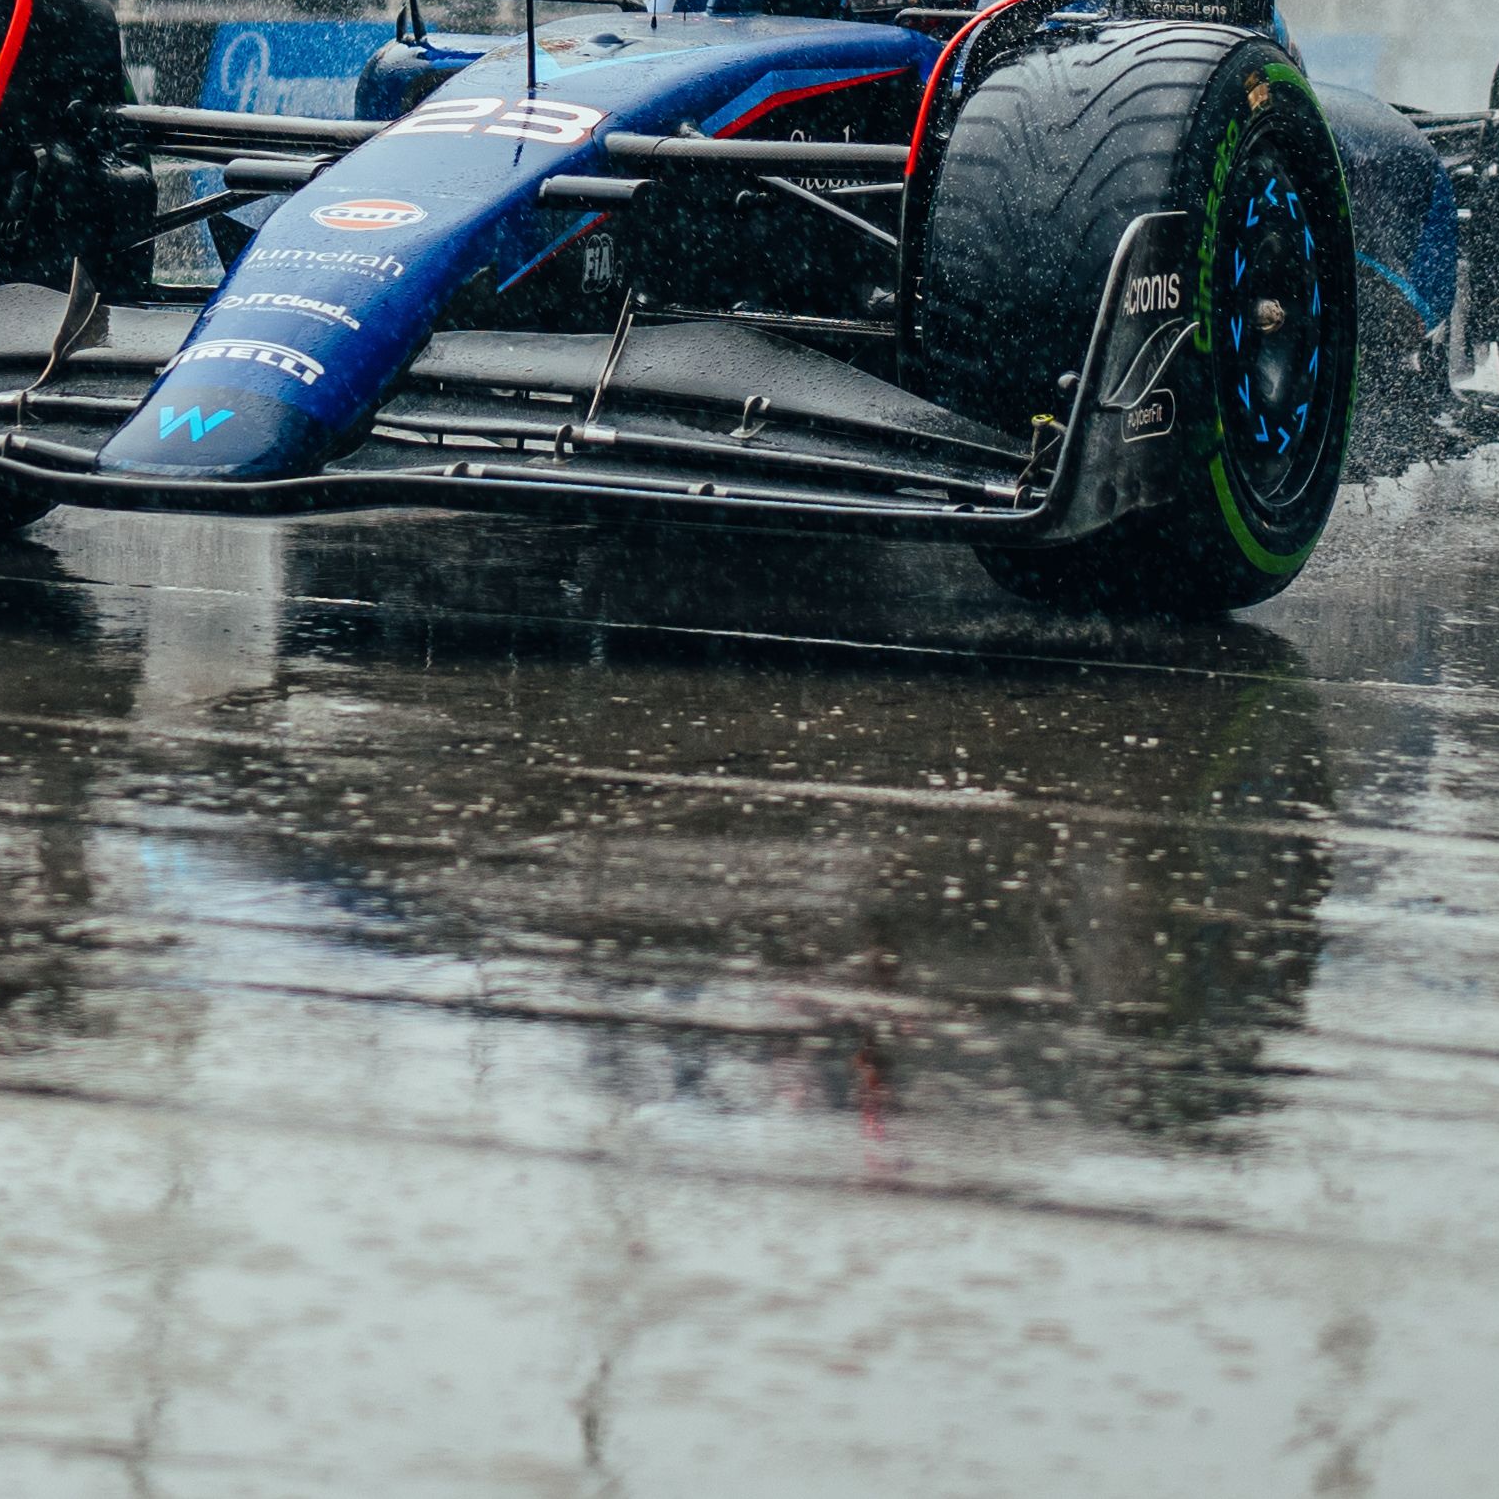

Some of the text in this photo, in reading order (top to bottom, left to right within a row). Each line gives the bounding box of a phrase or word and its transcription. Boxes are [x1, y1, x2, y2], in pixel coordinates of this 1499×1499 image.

[1153, 2, 1228, 16] causaLens
[384, 98, 605, 145] 23
[319, 207, 422, 222] Gulf
[247, 248, 406, 278] Jumeirah
[1121, 272, 1181, 317] Acronis
